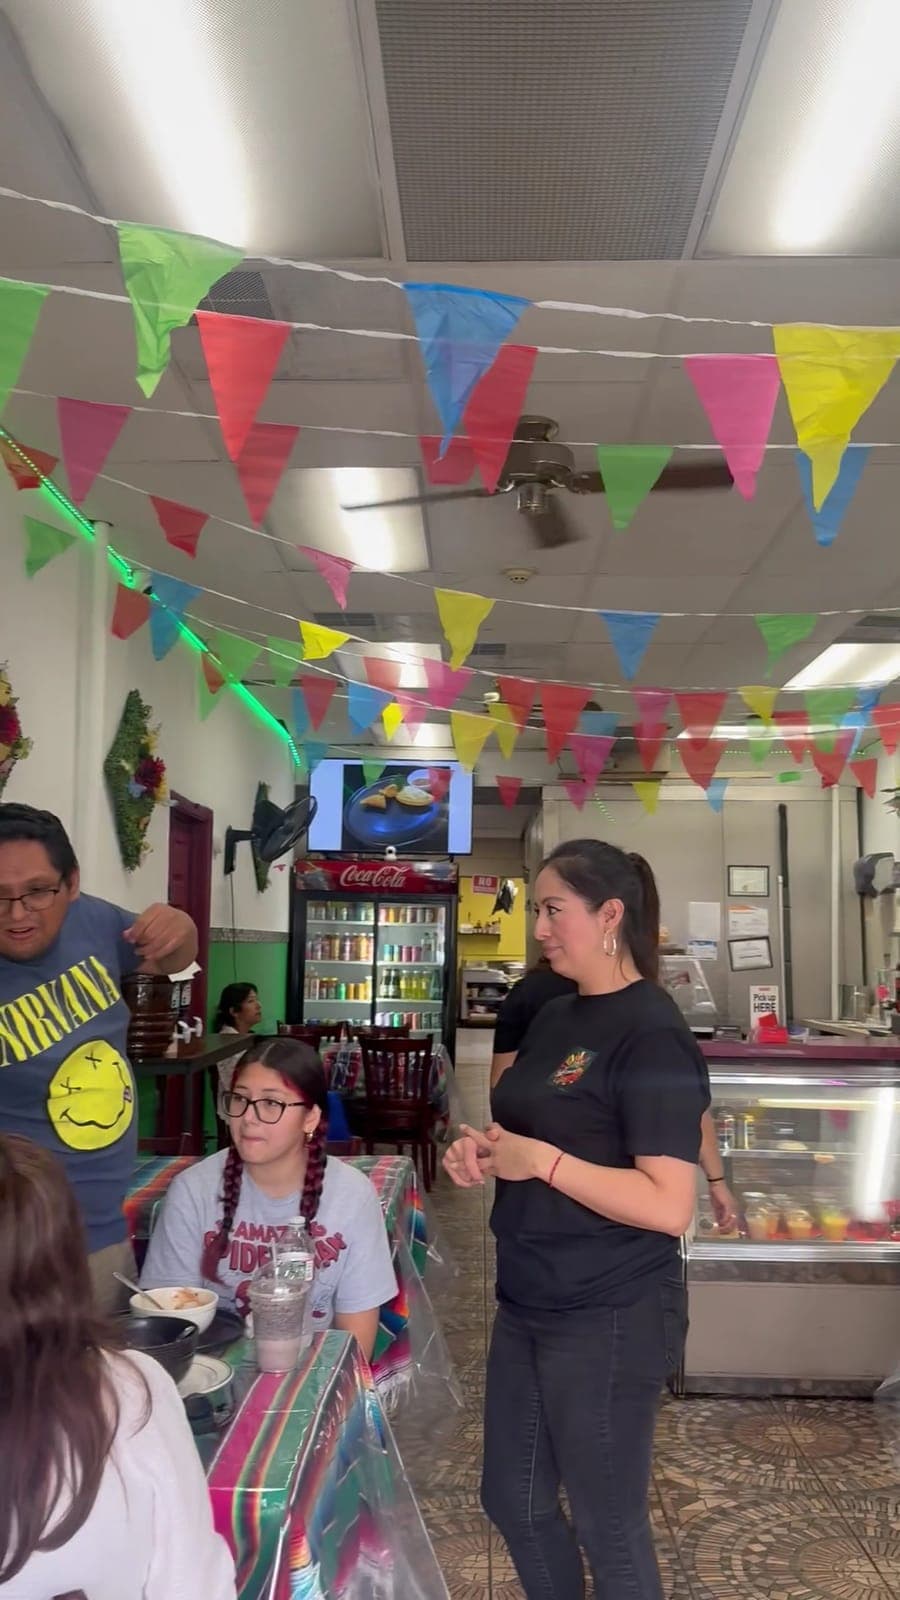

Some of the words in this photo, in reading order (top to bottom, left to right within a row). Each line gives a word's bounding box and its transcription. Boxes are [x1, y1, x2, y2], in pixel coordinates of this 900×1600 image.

[340, 865, 410, 888] Coca-Cola
[0, 955, 121, 1067] NIRVANA
[753, 1002, 776, 1013] HERE
